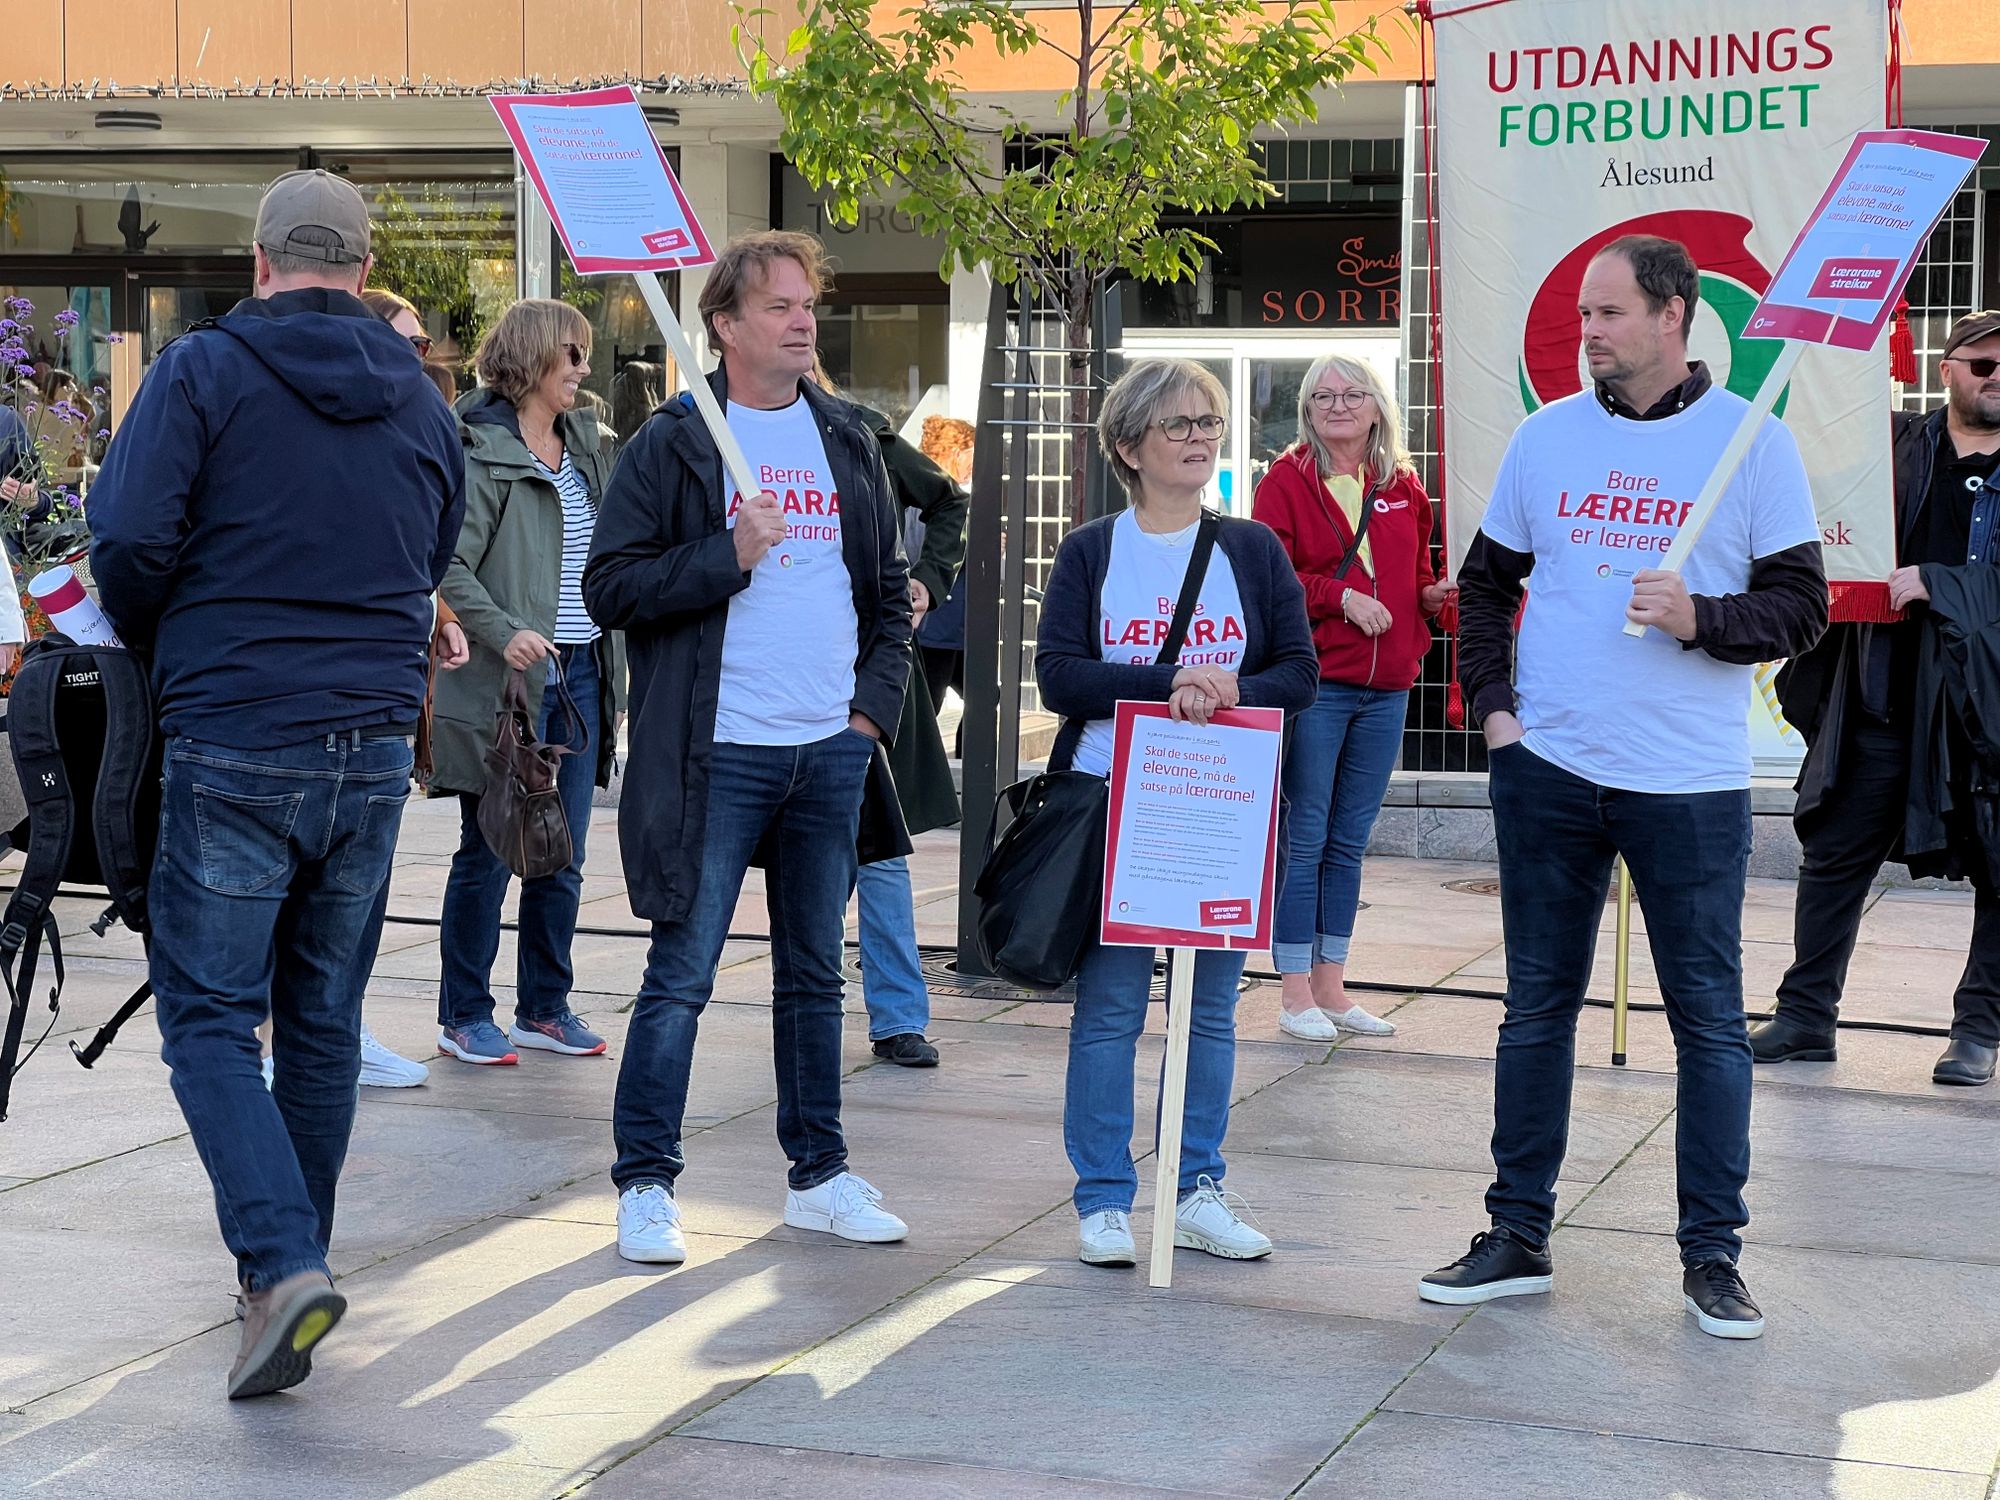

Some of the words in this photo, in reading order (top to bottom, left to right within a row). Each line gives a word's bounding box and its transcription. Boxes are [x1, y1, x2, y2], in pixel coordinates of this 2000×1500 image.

[1488, 25, 1834, 93] UTDANNINGS
[1499, 83, 1820, 148] FORBUNDET
[532, 124, 552, 134] Skal
[553, 126, 564, 135] de
[592, 125, 604, 137] på
[538, 135, 590, 149] elevane,
[591, 138, 605, 148] må
[582, 148, 643, 161] lærarane!
[1600, 156, 1715, 188] Ålesund
[1837, 195, 1876, 208] elevane,
[1877, 201, 1892, 211] må
[1892, 204, 1904, 213] de
[1857, 211, 1914, 231] lærarane!
[1830, 266, 1882, 278] Lærarane
[1830, 278, 1873, 289] streikar
[760, 465, 815, 484] Berre
[1606, 470, 1659, 492] Bare
[1571, 527, 1594, 545] er
[1599, 526, 1672, 553] lærere
[65, 671, 99, 683] TIGHT
[1145, 745, 1166, 757] Skal
[1168, 749, 1181, 759] de
[1183, 751, 1211, 763] satse
[1213, 754, 1227, 766] på
[1143, 760, 1201, 780] elevane,
[1203, 771, 1220, 782] må
[1223, 773, 1236, 783] de
[1140, 782, 1167, 793] satse
[1169, 785, 1183, 796] på
[1185, 782, 1255, 803] lærarane!
